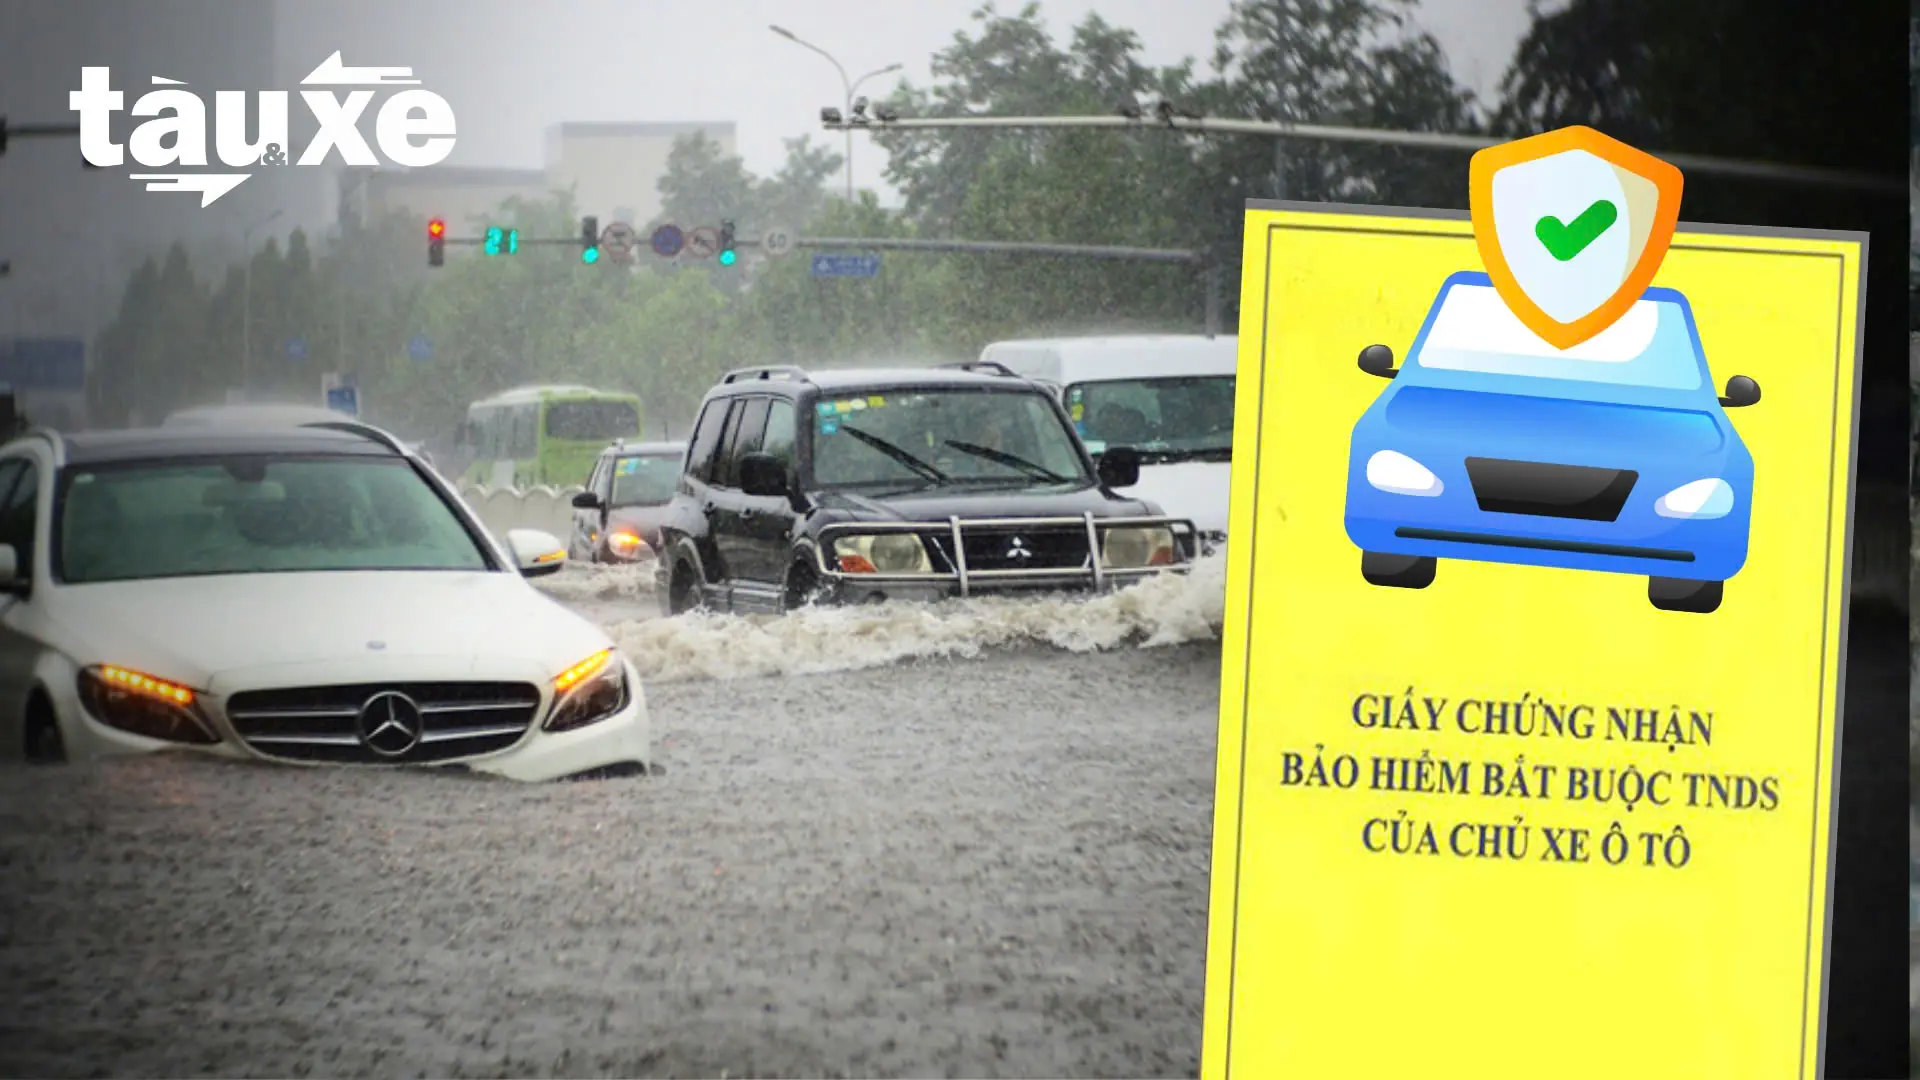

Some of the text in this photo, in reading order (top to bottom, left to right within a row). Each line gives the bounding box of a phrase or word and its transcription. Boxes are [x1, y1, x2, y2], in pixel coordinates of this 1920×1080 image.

[484, 226, 518, 255] 21
[767, 231, 788, 251] 60
[1352, 686, 1713, 753] GIẤY CHỨNG NHẬN
[1280, 744, 1780, 814] BẢO HIỂM BẮT BUỘC TNDS
[1362, 810, 1692, 868] CỦA CHỦ XE Ô TÔ
